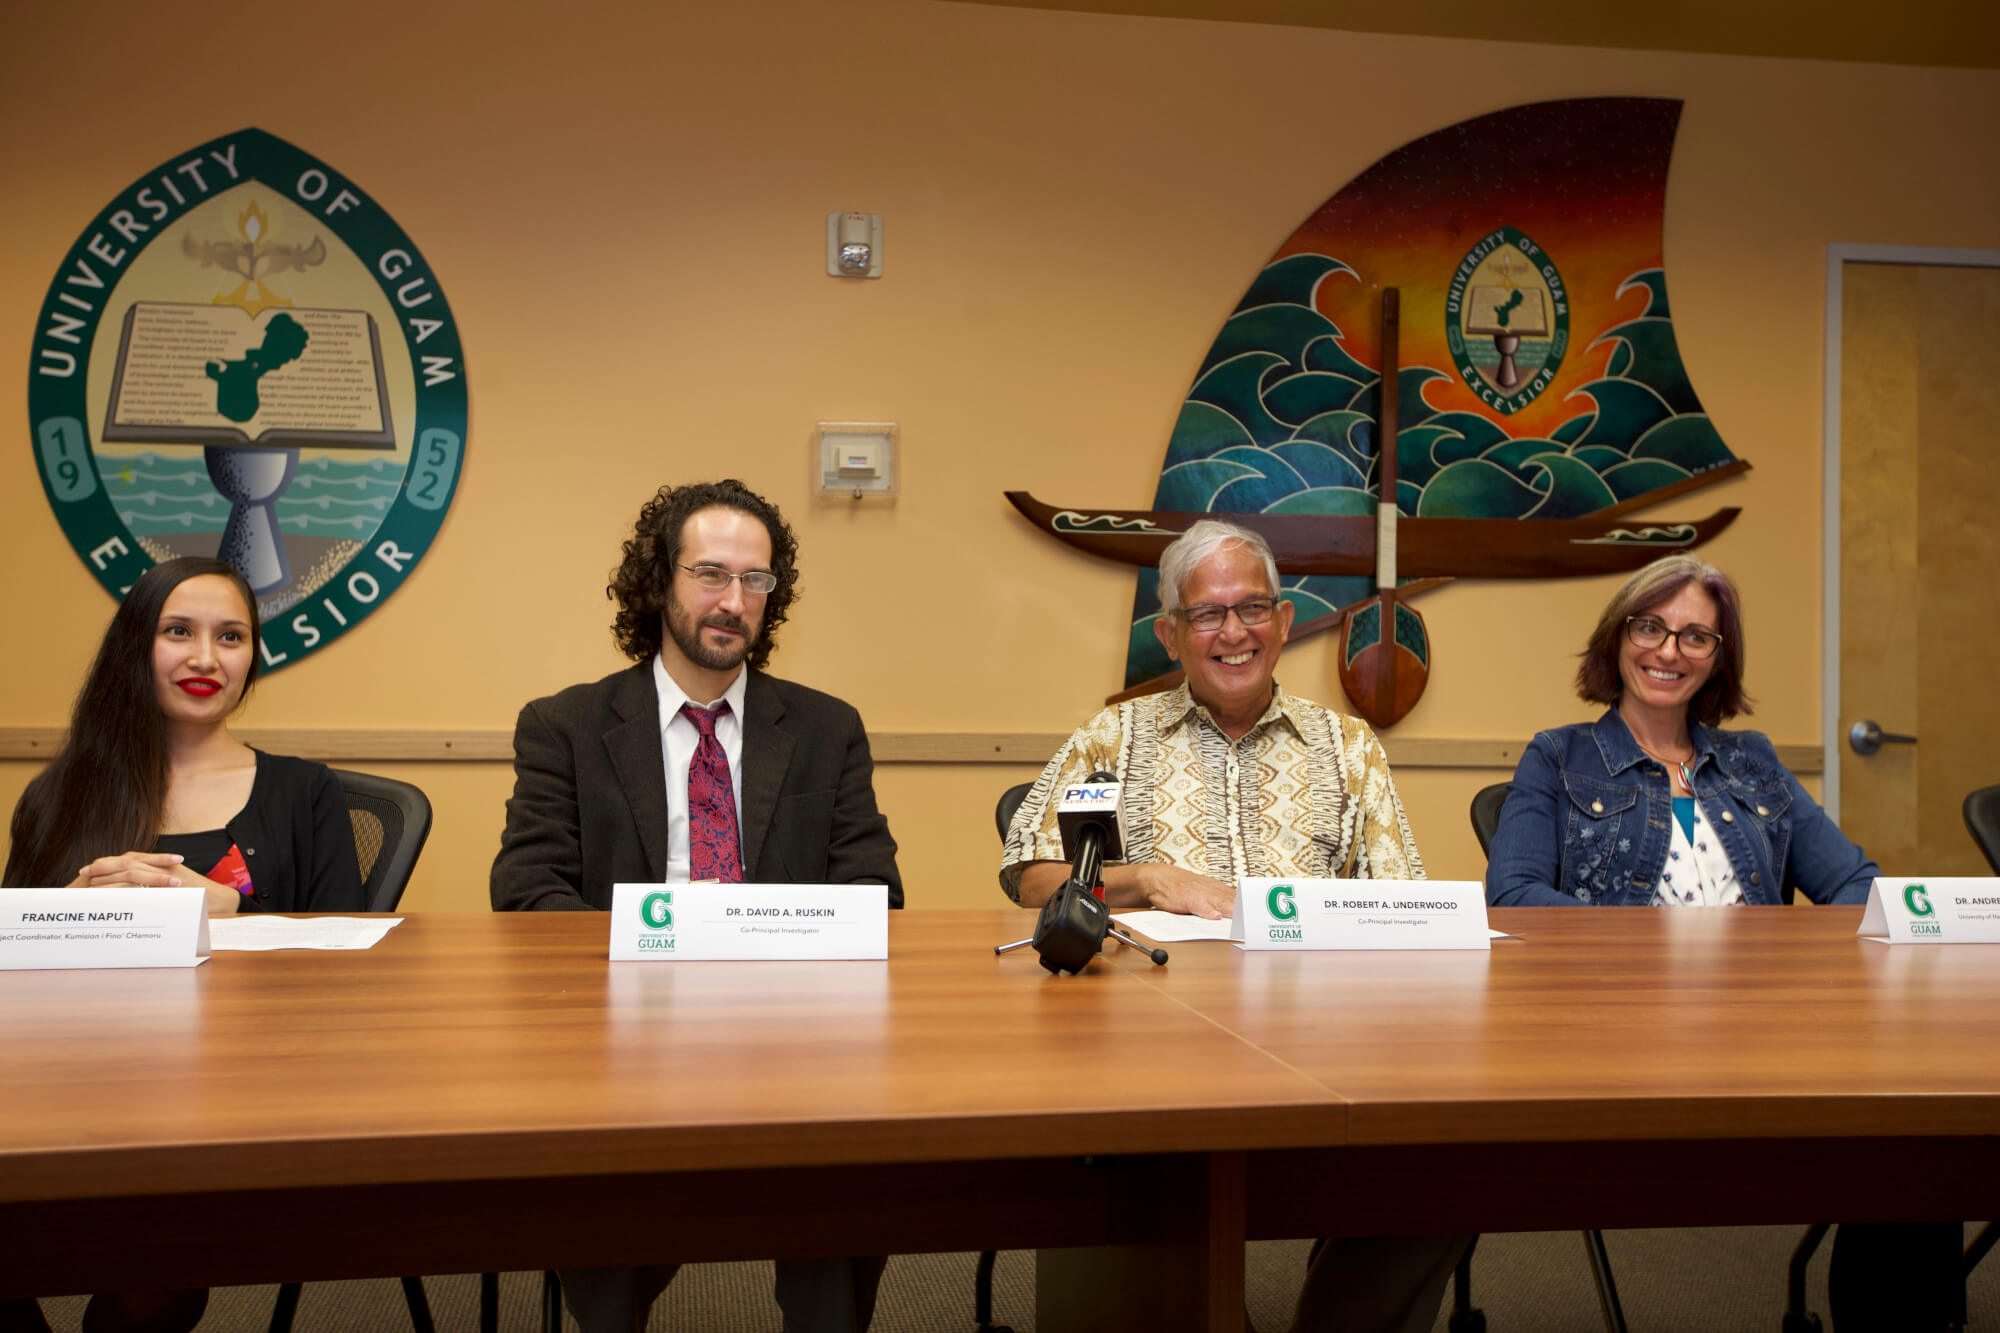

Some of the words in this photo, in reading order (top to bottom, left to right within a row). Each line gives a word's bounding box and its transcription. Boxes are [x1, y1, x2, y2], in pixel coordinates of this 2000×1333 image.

[39, 144, 240, 378] UNIVERSITY
[296, 169, 361, 217] OF
[379, 248, 457, 388] GUAM
[1447, 231, 1505, 314] UNIVERSITY
[1518, 238, 1540, 257] OF
[1542, 265, 1568, 317] GUAM
[1461, 364, 1555, 415] EXCELSIOR
[1064, 788, 1118, 800] PNC
[1324, 900, 1341, 909] DR.
[1343, 901, 1379, 909] ROBERT
[1381, 901, 1391, 909] A.
[1393, 901, 1458, 910] UNDERWOOD
[1955, 897, 1970, 905] DR.
[1972, 897, 2000, 905] ANDRE
[21, 912, 85, 922] FRANCINE
[88, 912, 134, 921] NAPUTI
[726, 908, 744, 917] DR.
[747, 908, 780, 917] DAVID
[782, 909, 793, 917] A.
[795, 909, 835, 917] RUSKIN
[1958, 913, 1985, 921] University
[1357, 918, 1393, 926] Co-Principal
[1394, 918, 1428, 926] Investigator
[740, 926, 780, 935] Co-Principal
[781, 926, 820, 935] Investigator
[1269, 929, 1302, 939] GUAM
[1910, 925, 1941, 934] GUAM
[15, 933, 63, 941] Coordinator,
[65, 932, 100, 940] Kumision
[126, 932, 162, 940] CHamoru
[638, 938, 675, 949] GUAM
